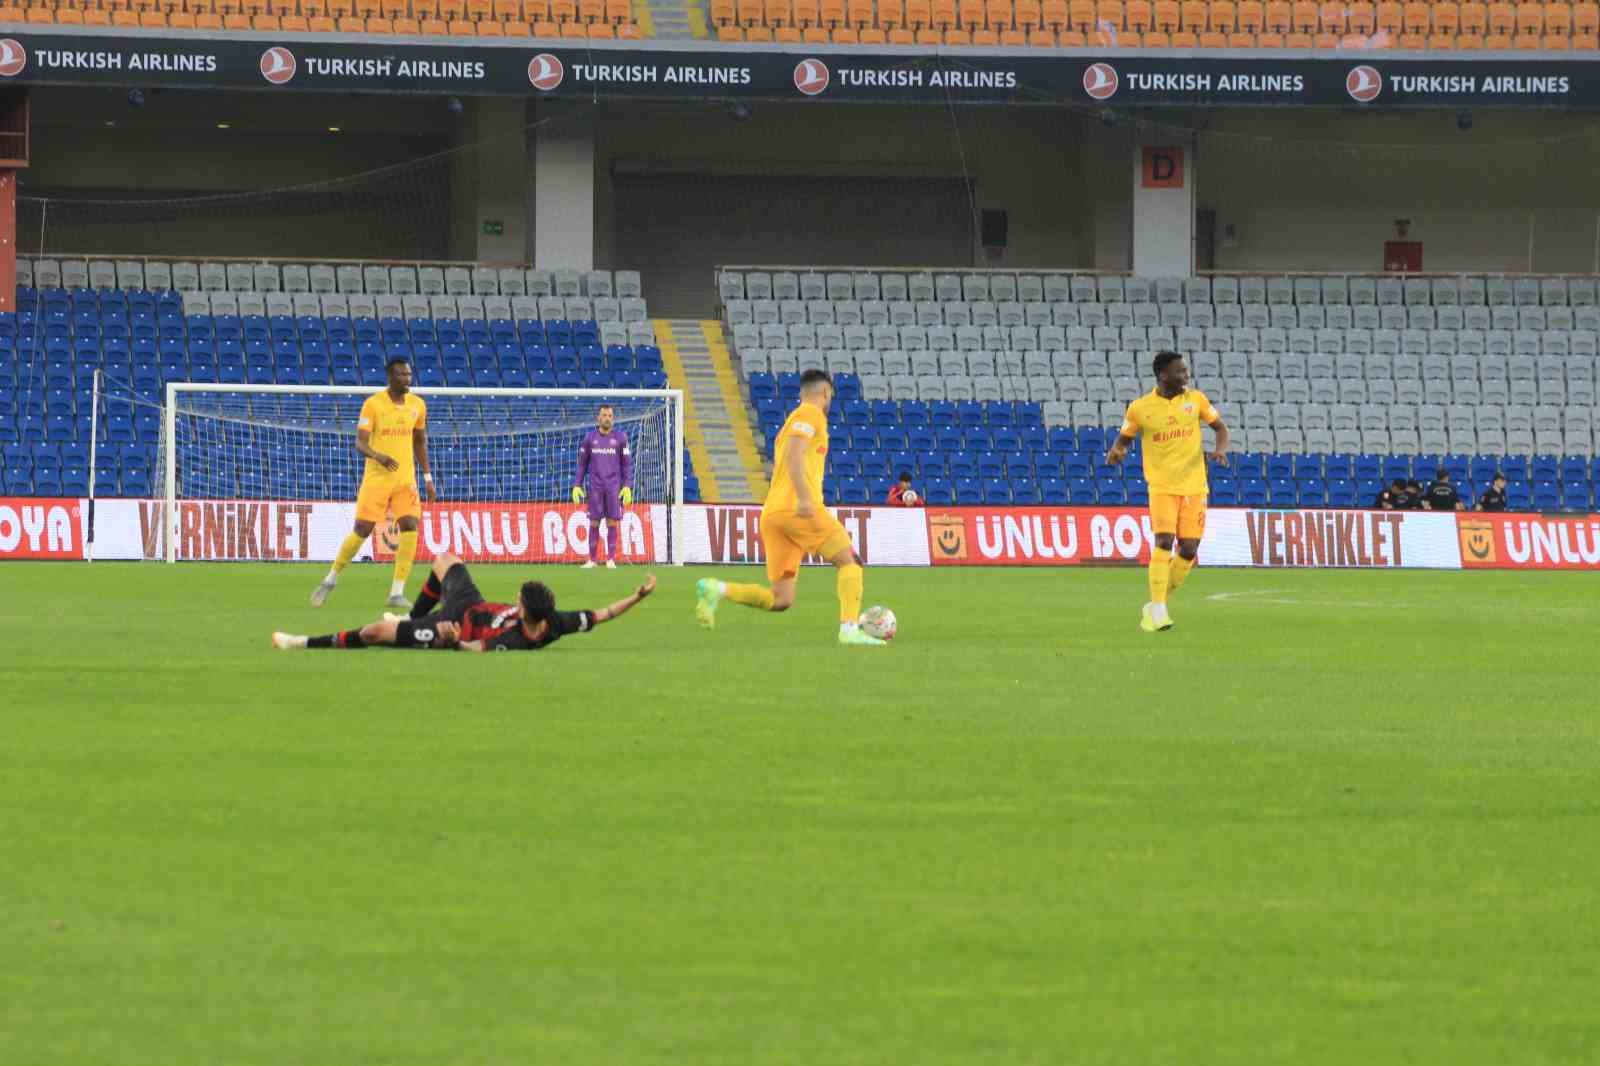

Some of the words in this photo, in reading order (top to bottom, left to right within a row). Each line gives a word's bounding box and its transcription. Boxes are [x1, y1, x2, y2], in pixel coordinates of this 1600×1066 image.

[34, 49, 121, 69] TURKISH
[127, 52, 217, 72] AIRLINES
[304, 57, 391, 76] TURKISH
[396, 60, 485, 79] AIRLINES
[571, 64, 657, 82] TURKISH
[663, 66, 751, 84] AIRLINES
[837, 69, 922, 86] TURKISH
[928, 70, 1017, 88] AIRLINES
[1126, 73, 1210, 91] TURKISH
[1216, 74, 1304, 92] AIRLINES
[1390, 75, 1475, 93] TURKISH
[1481, 76, 1569, 93] AIRLINES
[1152, 155, 1174, 180] D
[422, 510, 529, 557] ÜNLÜ
[976, 515, 1078, 559] ÜNLÜ
[1503, 520, 1600, 564] ÜNLÜ
